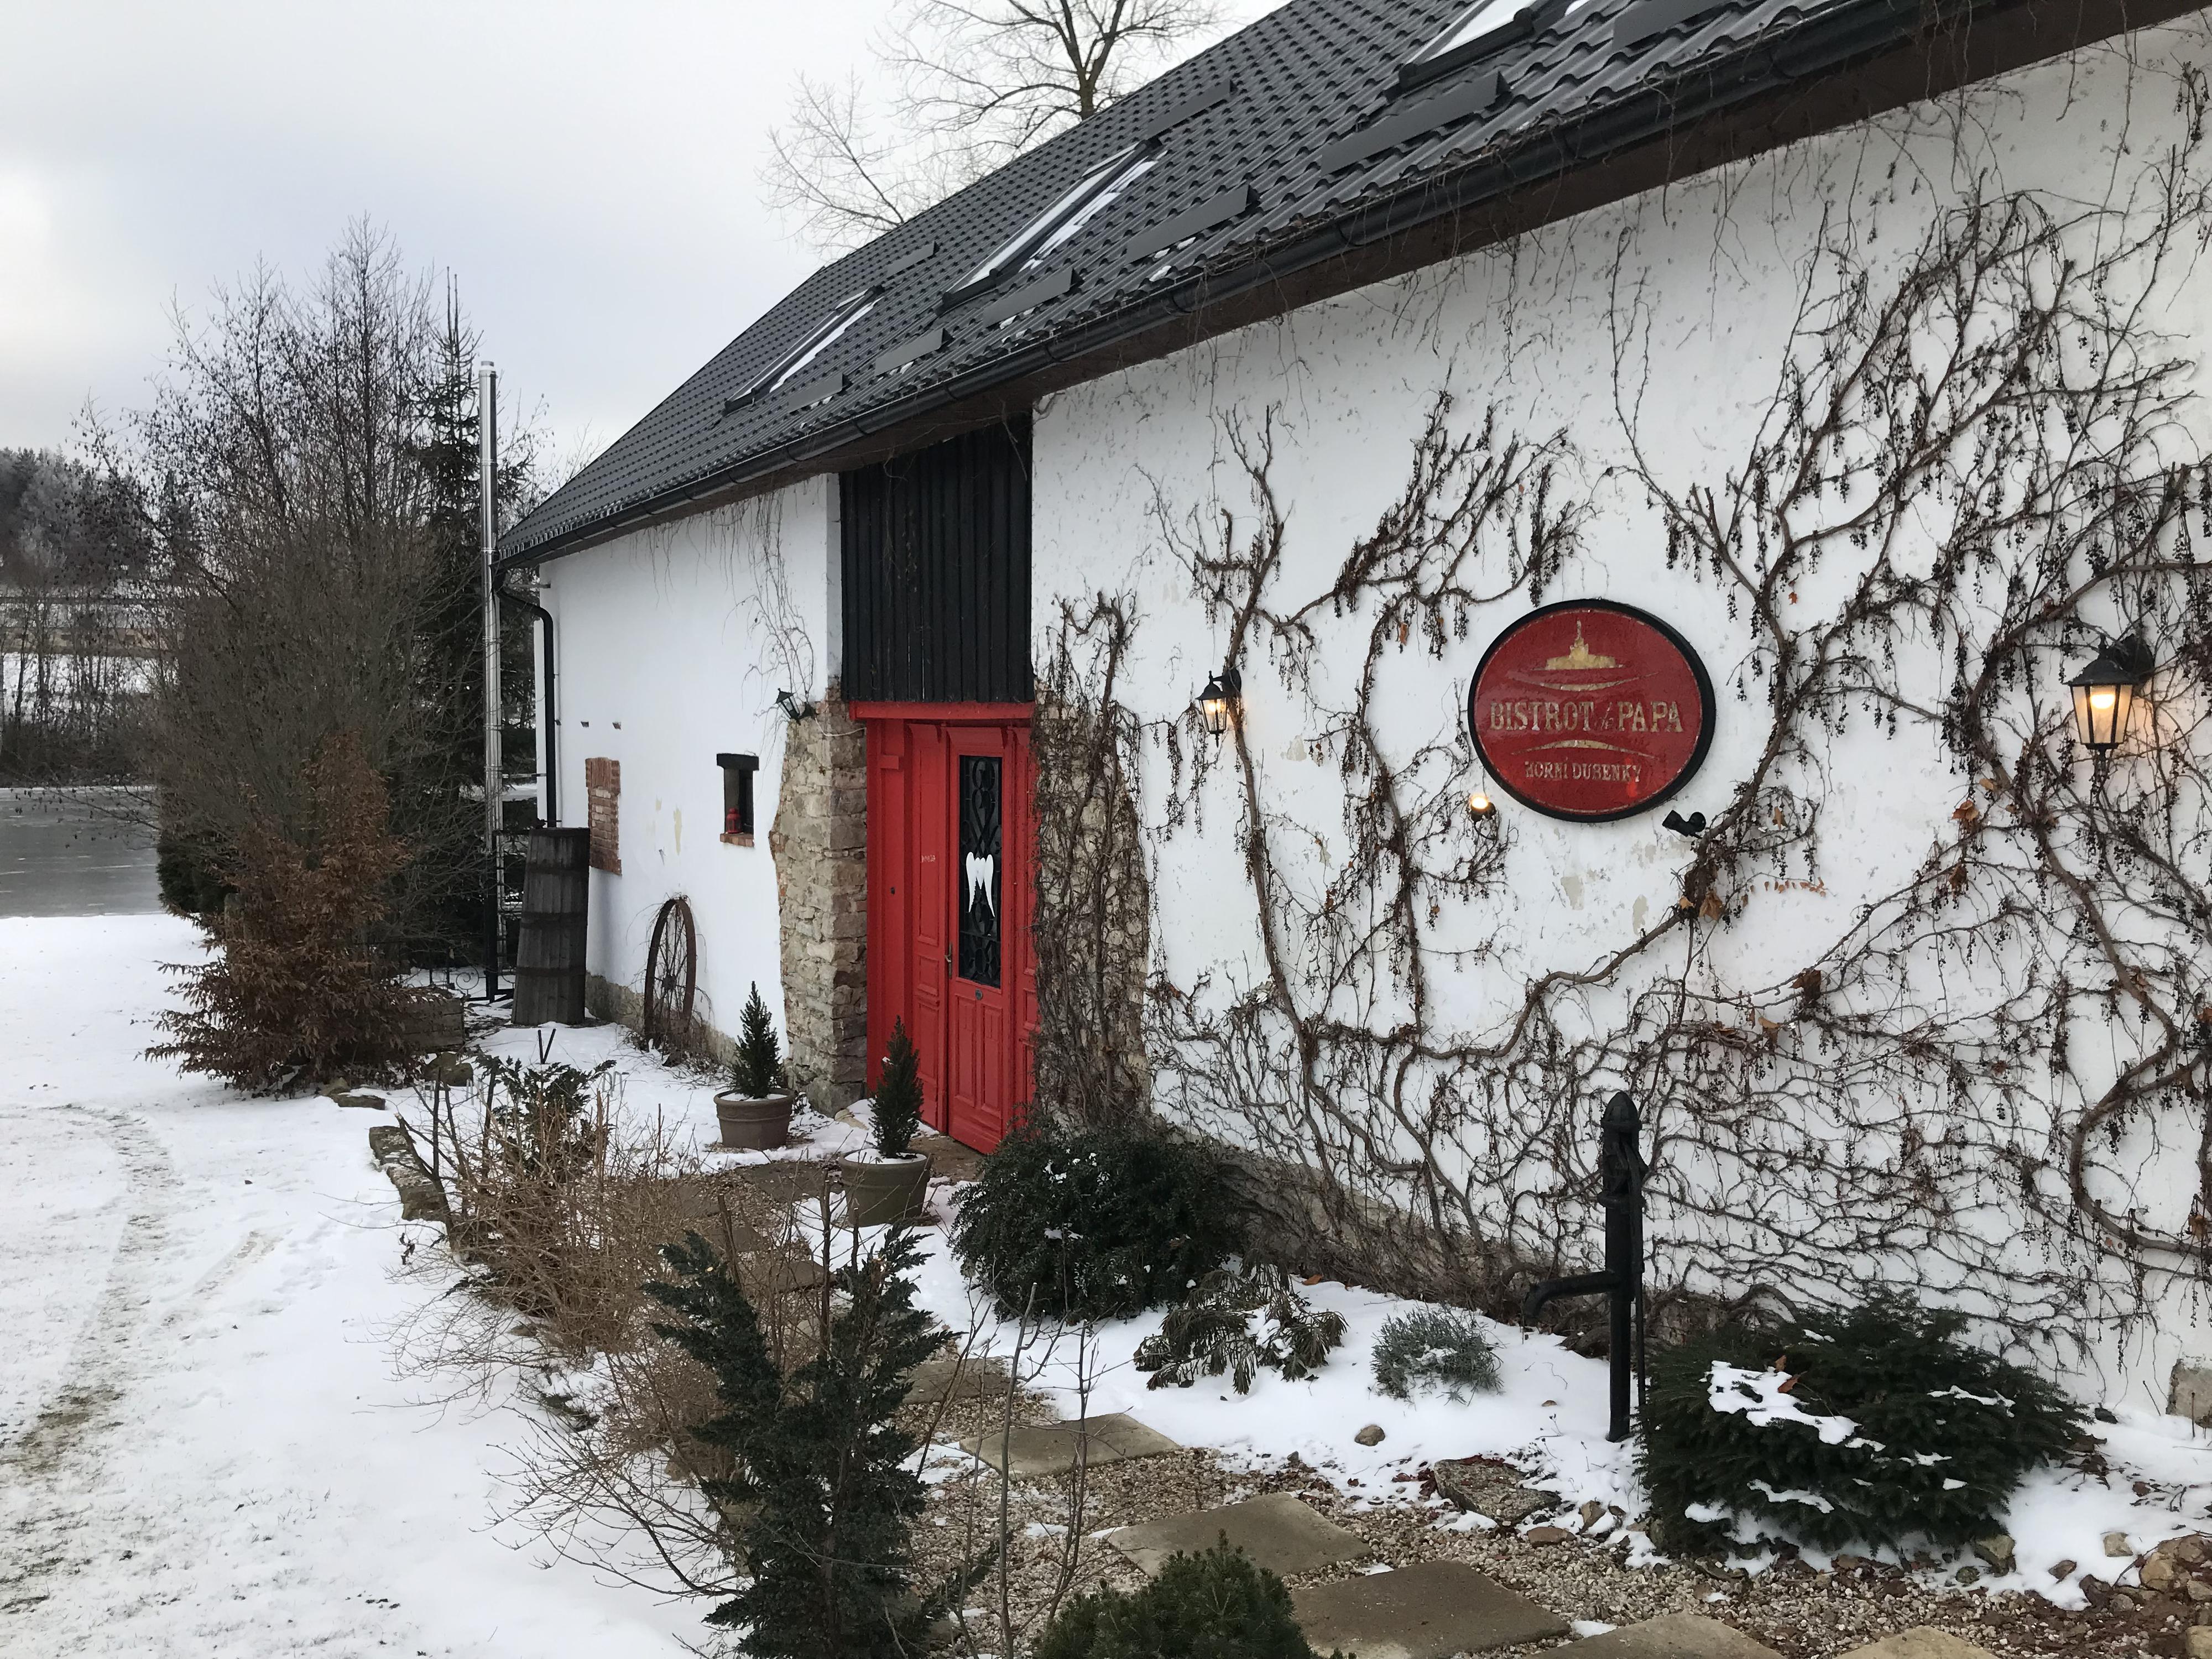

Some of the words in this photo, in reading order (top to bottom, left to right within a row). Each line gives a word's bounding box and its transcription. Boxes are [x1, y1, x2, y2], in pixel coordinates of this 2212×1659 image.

[1490, 701, 1594, 731] BISTROT
[1617, 701, 1683, 732] PAPA
[1572, 762, 1641, 782] DUBENKY
